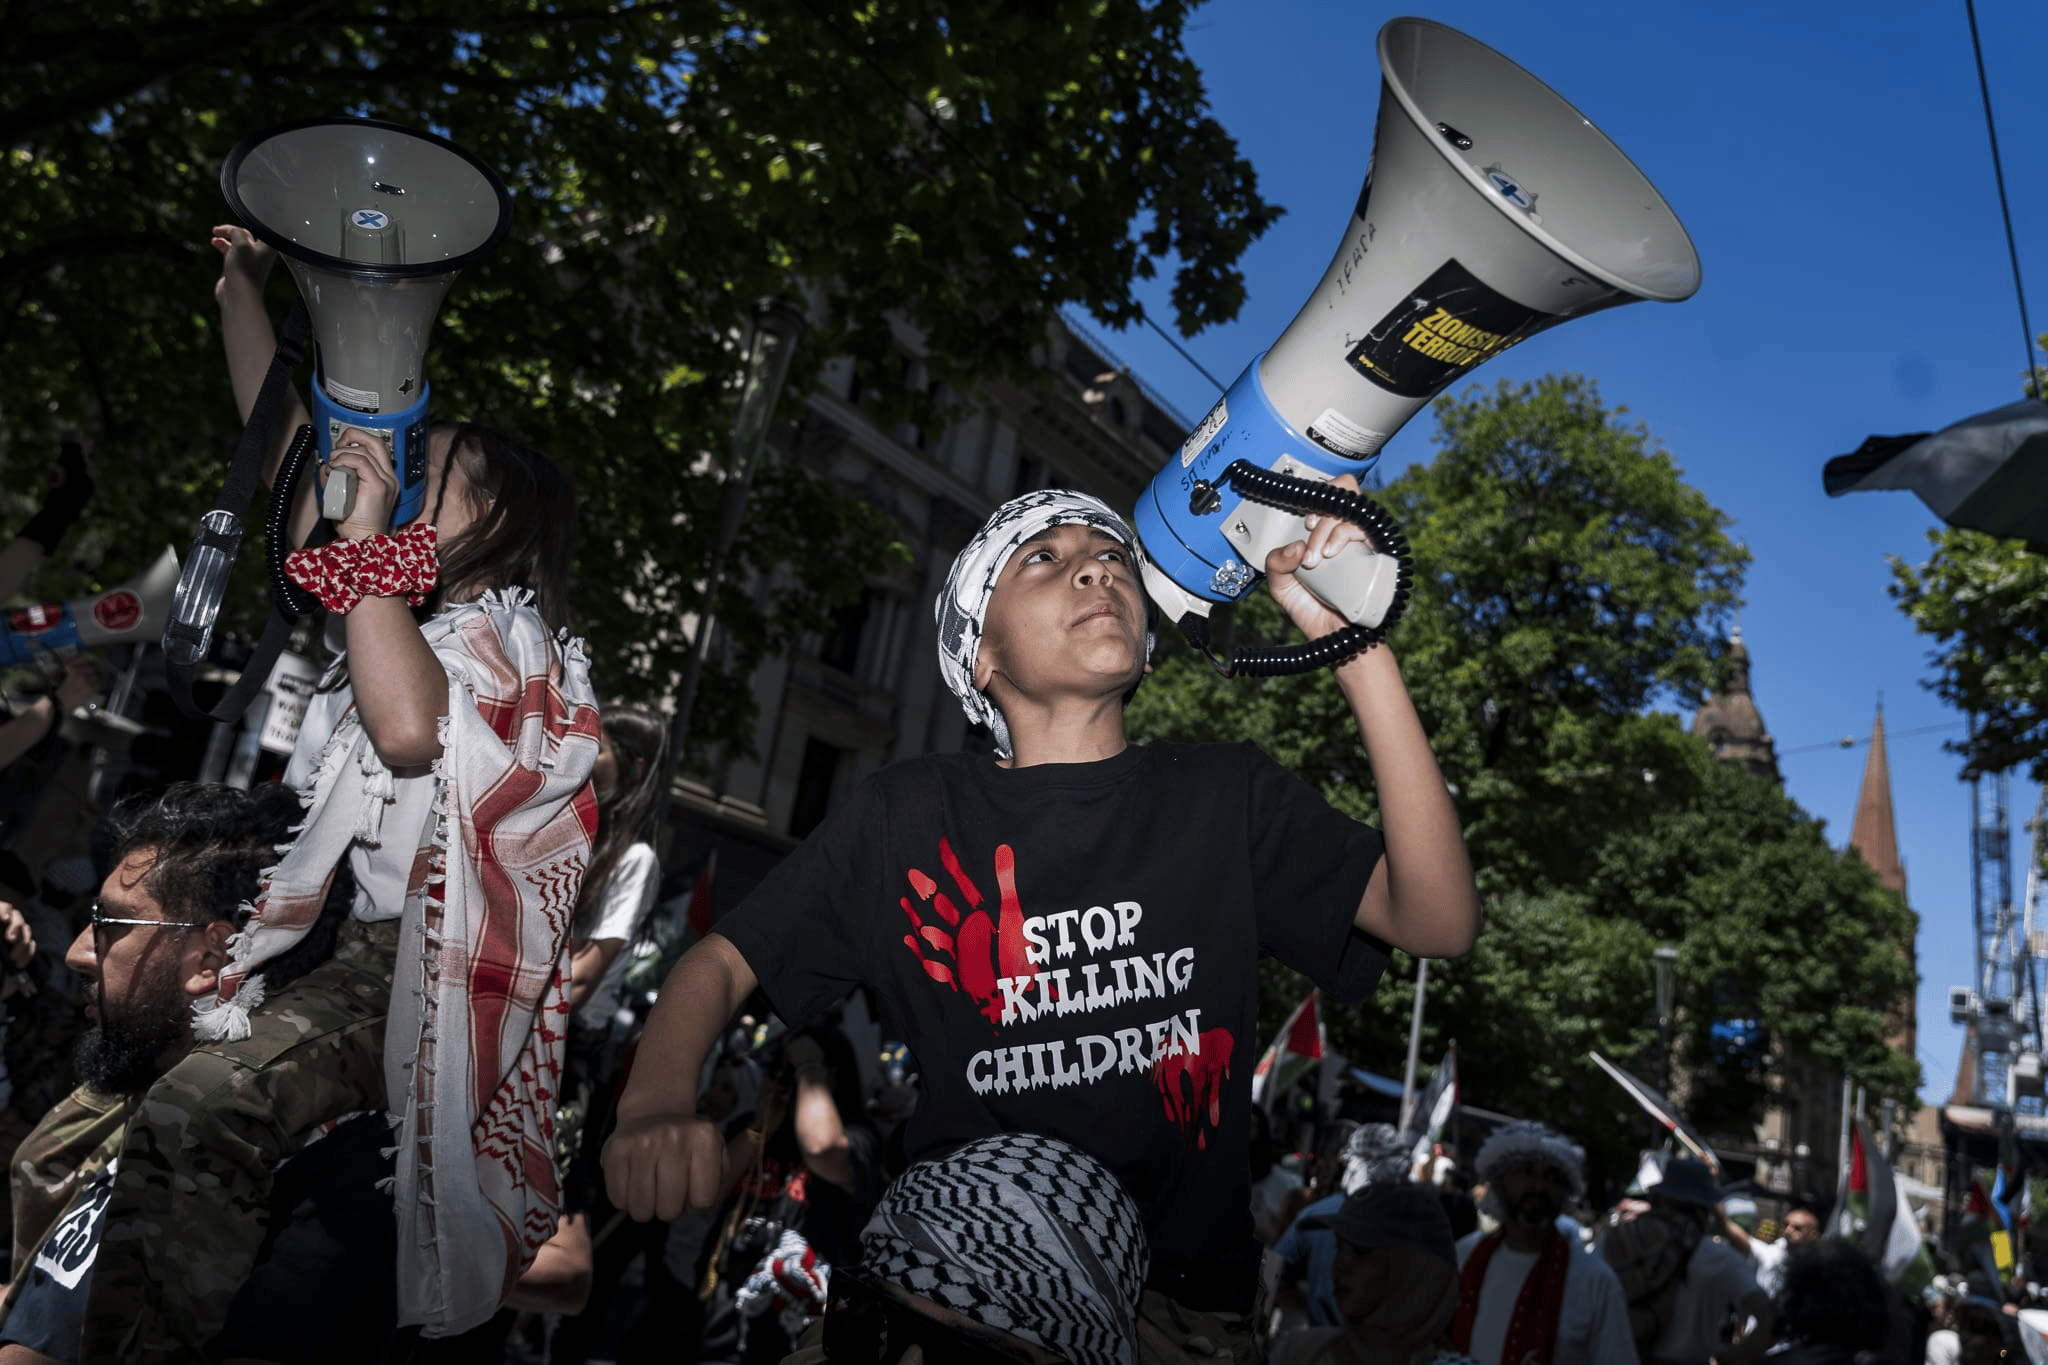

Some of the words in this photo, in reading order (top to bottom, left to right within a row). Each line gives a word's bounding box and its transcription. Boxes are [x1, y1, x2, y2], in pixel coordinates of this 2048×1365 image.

[1022, 901, 1143, 966] STOP
[996, 947, 1195, 1028] KILLING
[966, 1008, 1202, 1097] CHILDREN
